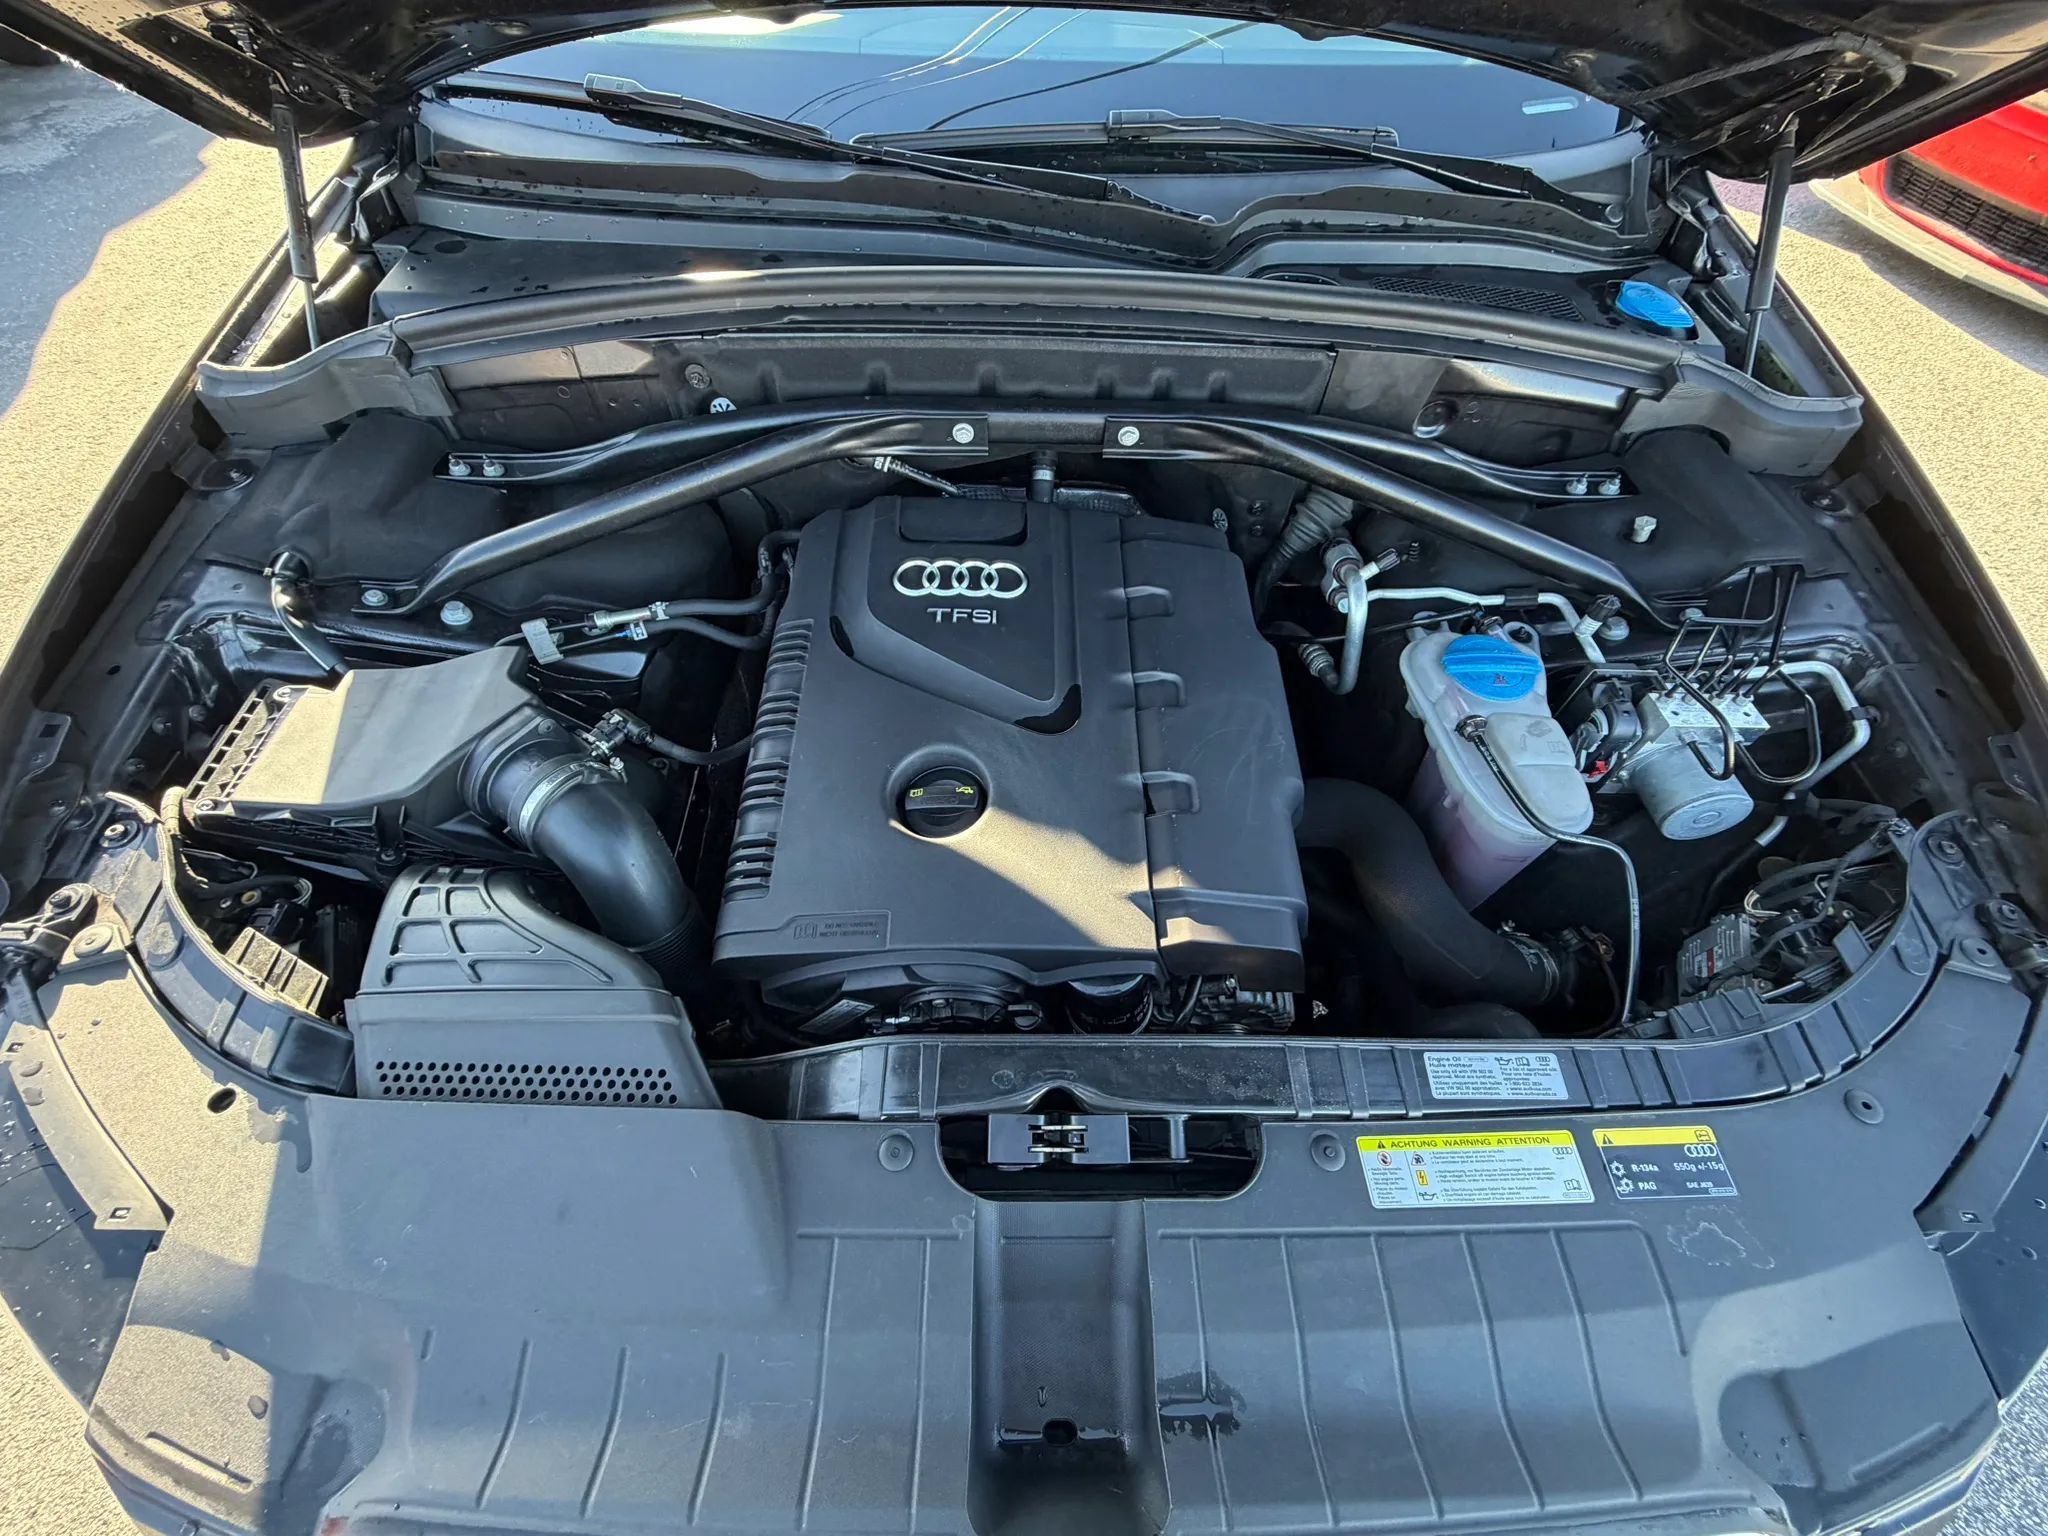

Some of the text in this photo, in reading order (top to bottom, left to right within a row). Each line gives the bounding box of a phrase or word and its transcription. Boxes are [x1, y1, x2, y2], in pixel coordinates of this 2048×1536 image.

[927, 607, 997, 625] TFSI
[1390, 1136, 1551, 1149] ACHTUNG WARNING ATTENTION
[1631, 1161, 1725, 1172] R-134a 550g +/-15g
[1638, 1181, 1657, 1190] PAG
